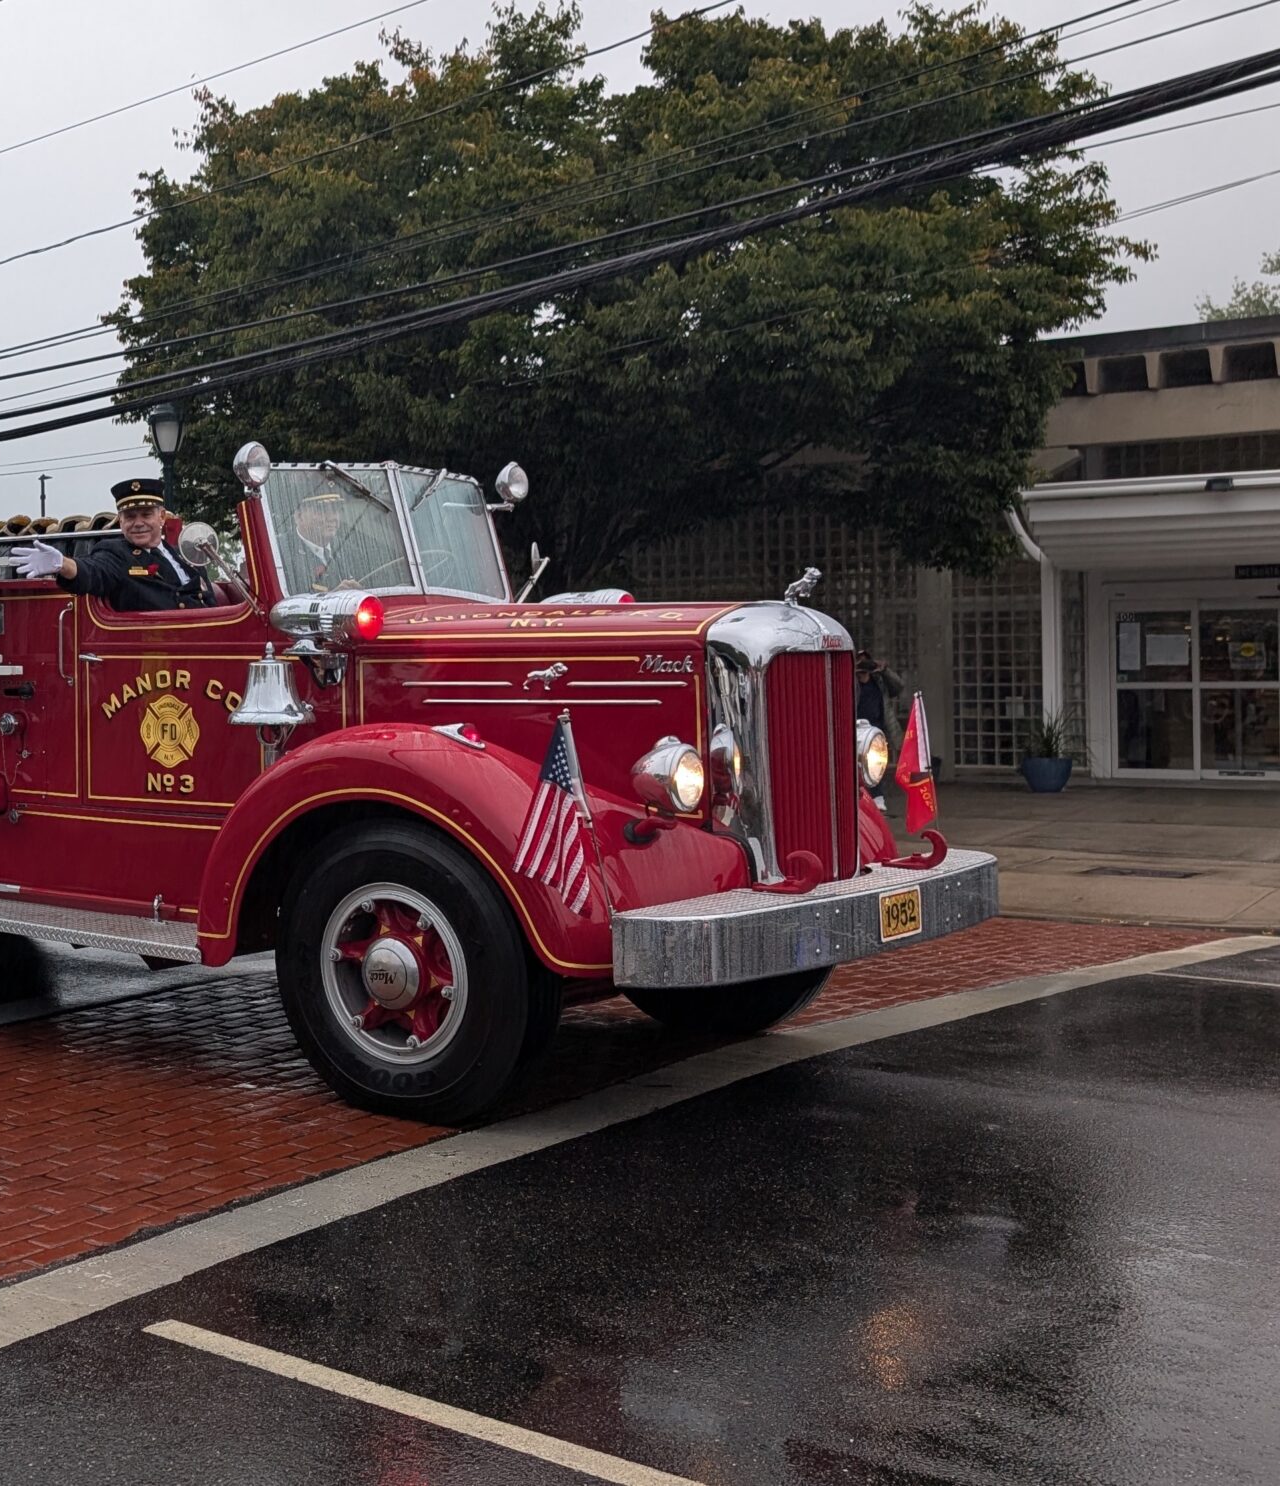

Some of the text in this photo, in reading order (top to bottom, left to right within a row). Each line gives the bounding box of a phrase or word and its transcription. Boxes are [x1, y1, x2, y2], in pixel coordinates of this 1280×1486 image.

[408, 609, 612, 625] UNIONDALE
[510, 618, 564, 628] N.Y.
[637, 654, 694, 674] Mack
[101, 669, 192, 720] MANOR
[161, 723, 177, 741] FD
[180, 774, 195, 793] 3
[886, 899, 917, 931] 1952
